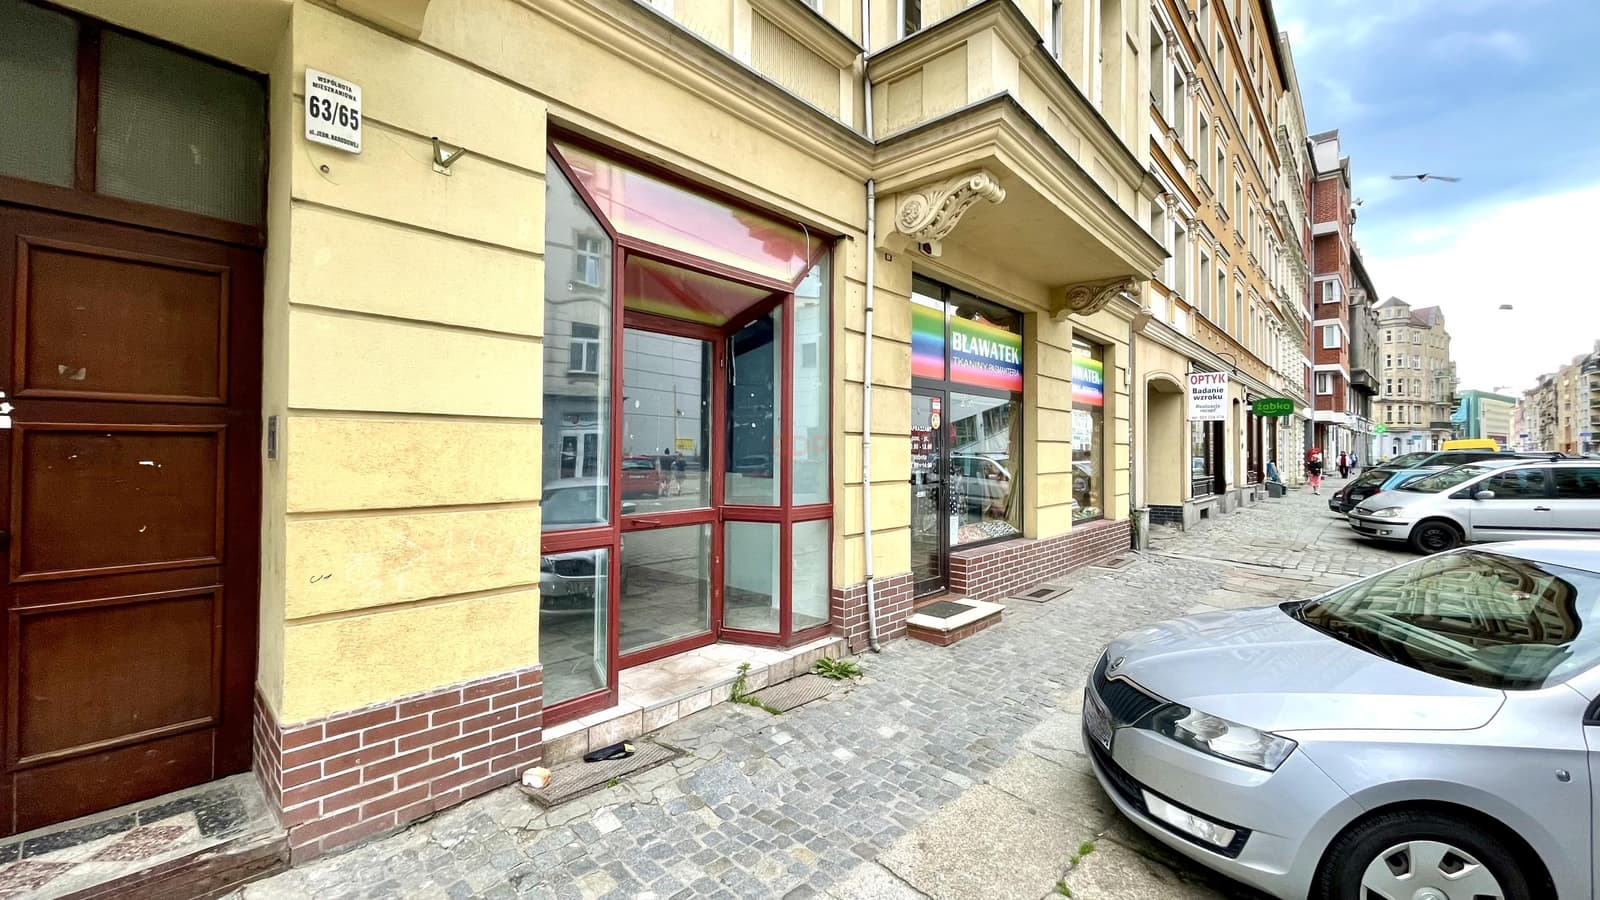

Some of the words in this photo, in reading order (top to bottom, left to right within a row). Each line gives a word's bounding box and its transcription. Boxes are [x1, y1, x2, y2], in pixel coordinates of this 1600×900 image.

[309, 95, 359, 131] 63/65
[952, 331, 1020, 365] BŁAWATEK
[1190, 373, 1226, 385] OPTYK
